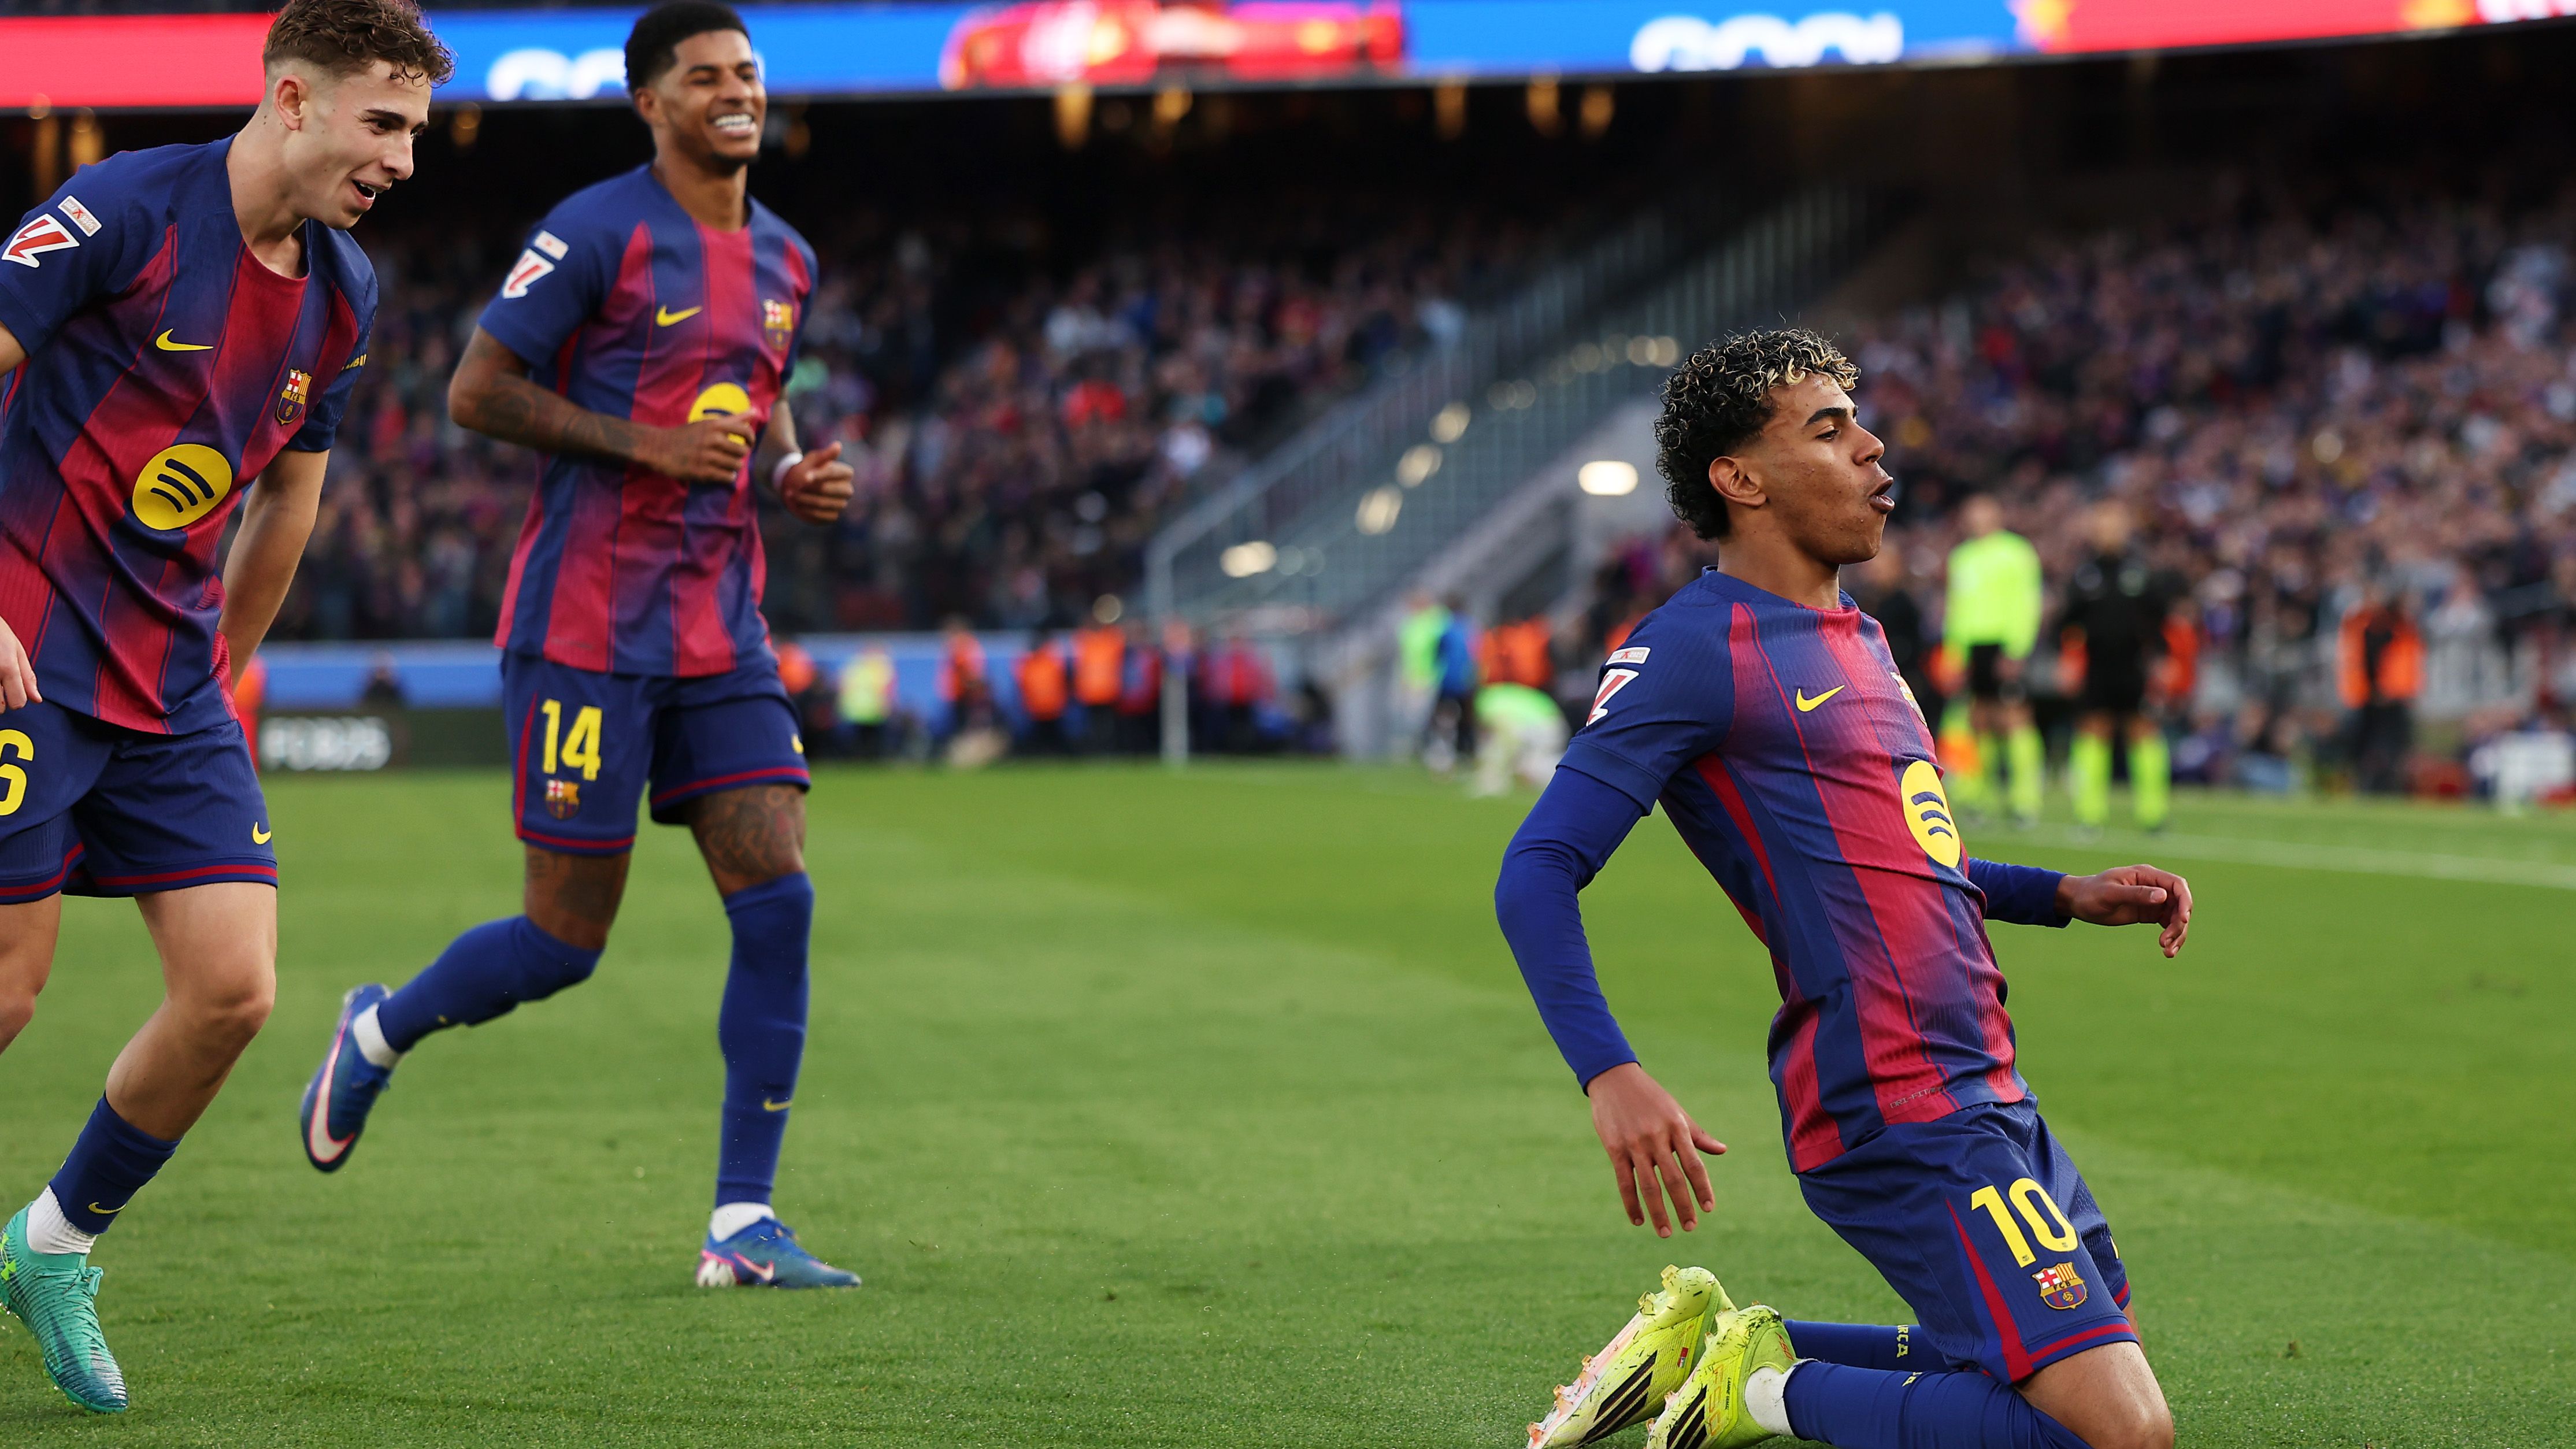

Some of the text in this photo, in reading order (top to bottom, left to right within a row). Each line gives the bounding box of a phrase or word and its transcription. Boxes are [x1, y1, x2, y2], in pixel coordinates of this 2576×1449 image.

[289, 392, 300, 402] FCB
[541, 698, 603, 781] 14
[0, 729, 34, 816] 6
[1889, 1088, 1929, 1109] DRI-FIT
[1971, 1177, 2079, 1268] 10
[2053, 1281, 2071, 1291] FCB
